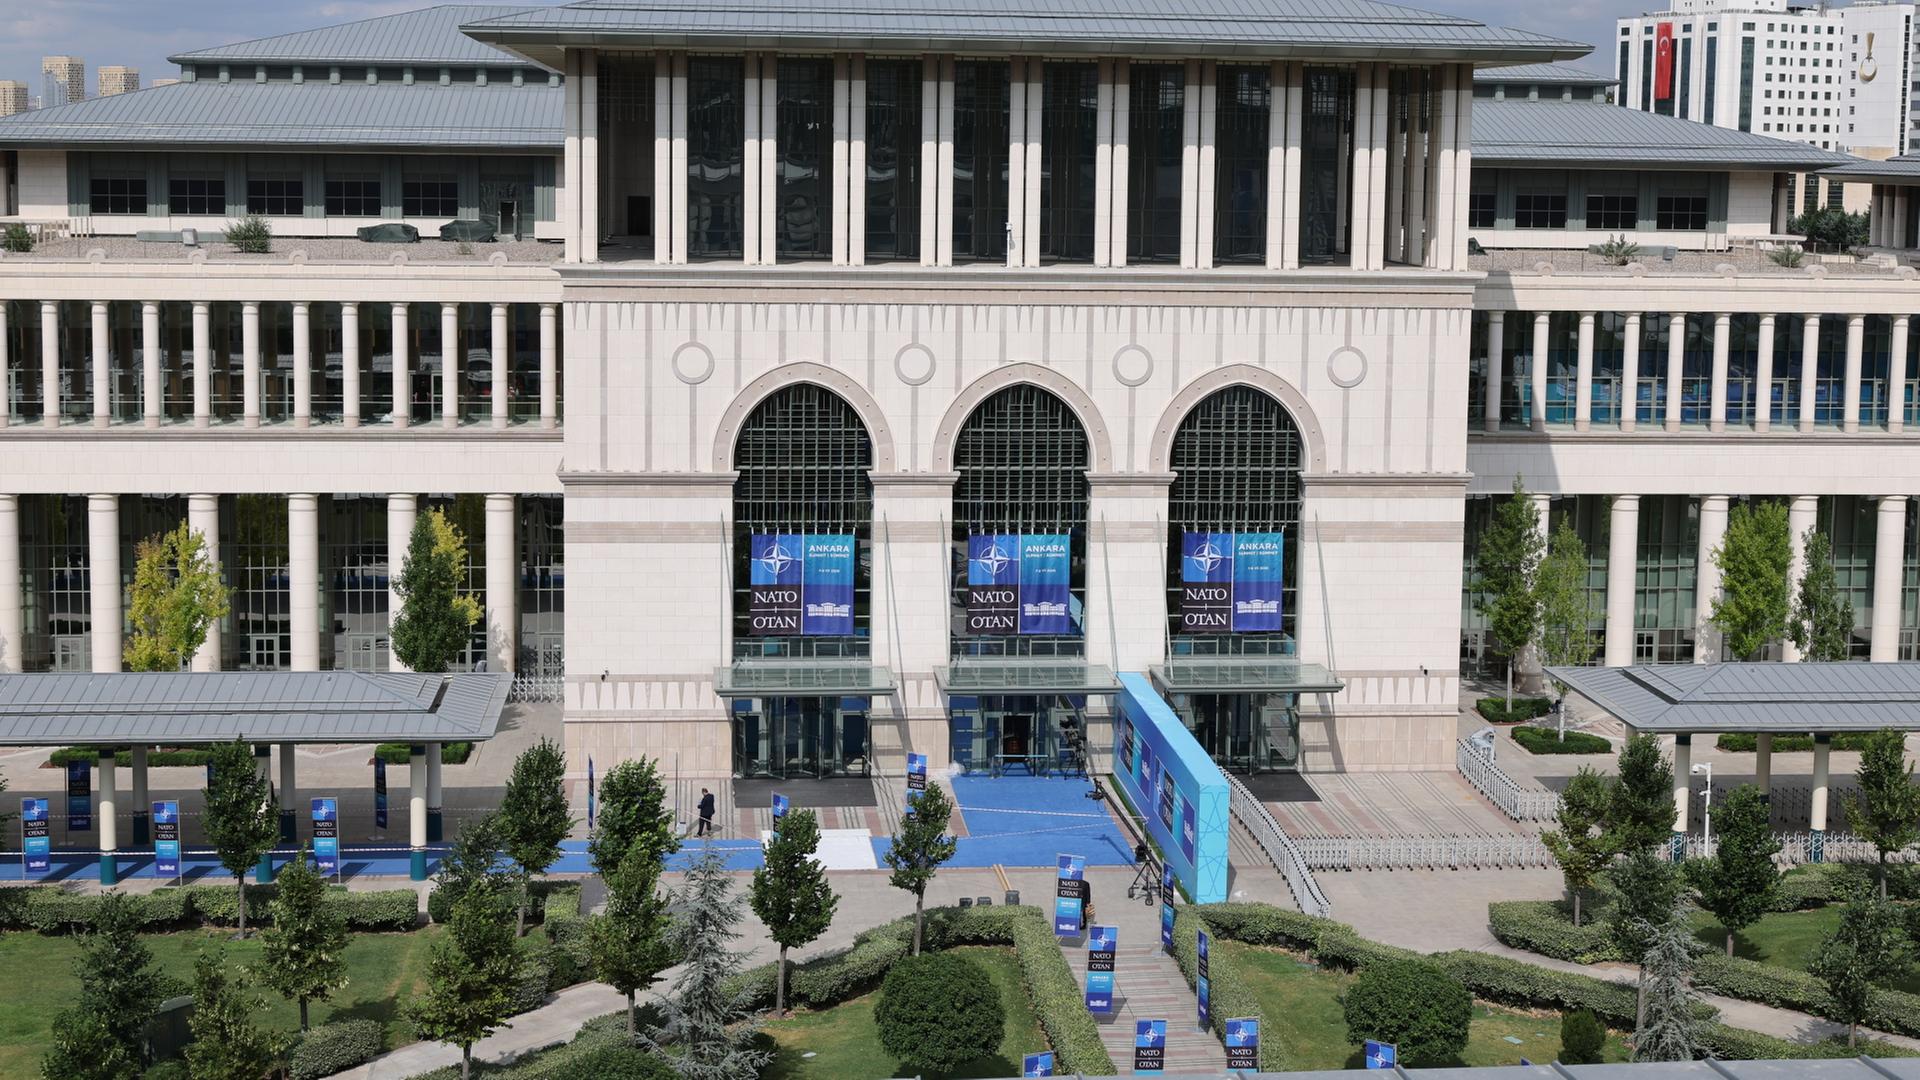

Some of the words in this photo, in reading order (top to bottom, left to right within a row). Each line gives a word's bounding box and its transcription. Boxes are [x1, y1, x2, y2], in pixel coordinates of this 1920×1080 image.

[755, 591, 797, 603] NATO
[972, 591, 1014, 603] NATO
[1186, 588, 1227, 600] NATO
[753, 616, 796, 629] OTAN
[971, 616, 1014, 628] OTAN
[1185, 614, 1226, 625] OTAN
